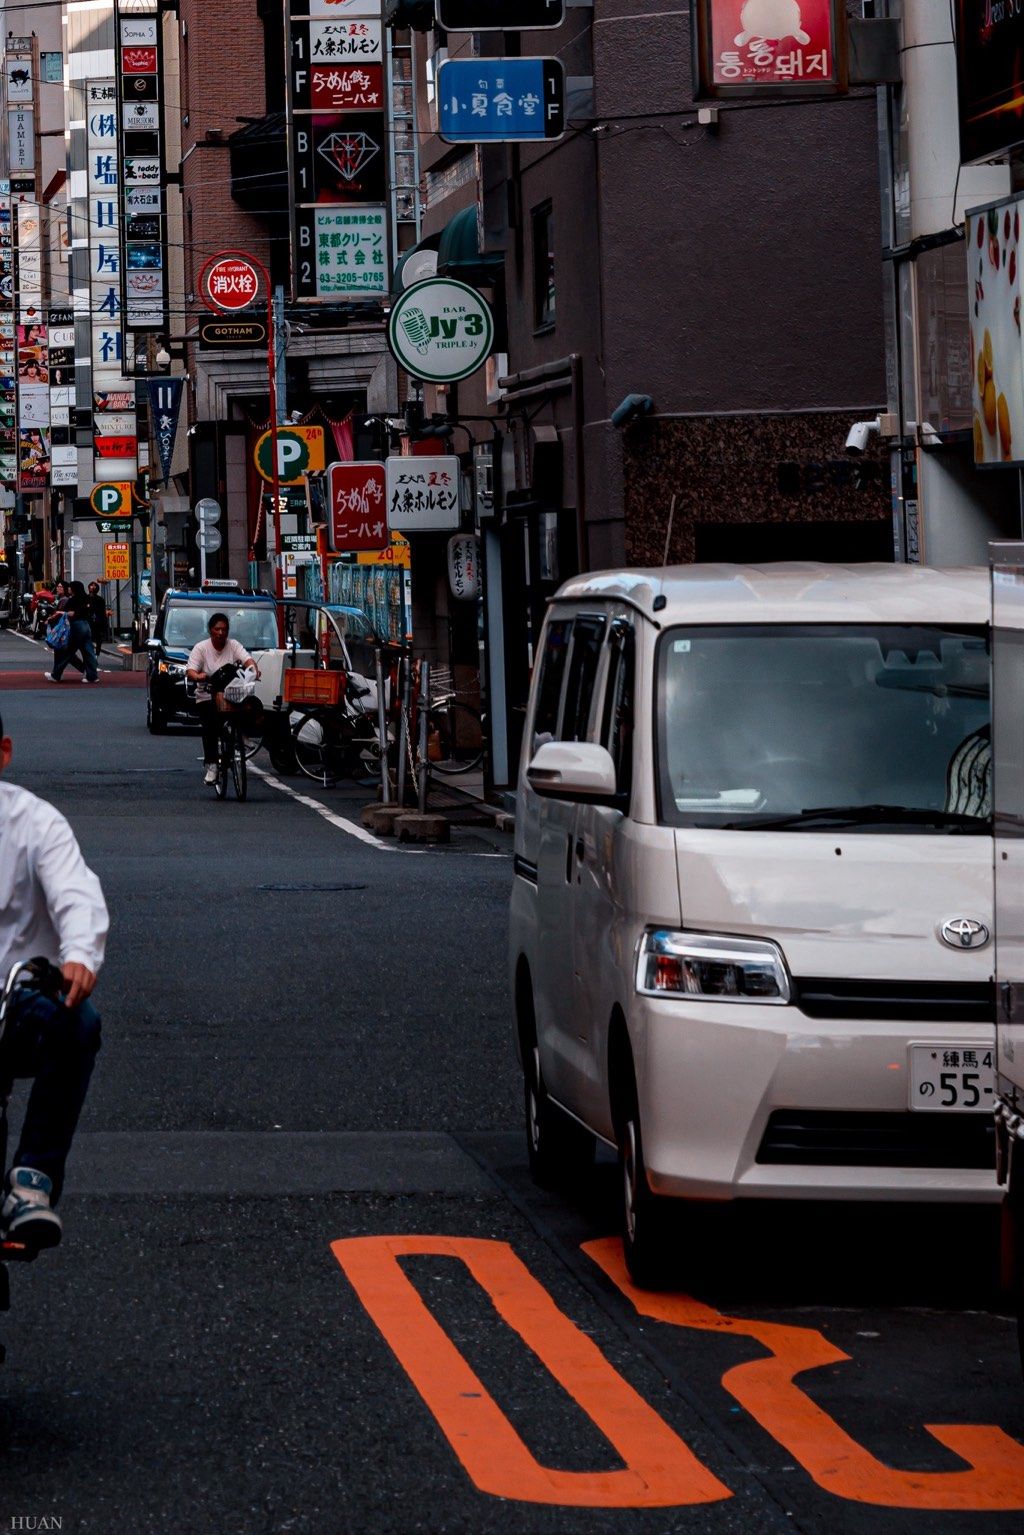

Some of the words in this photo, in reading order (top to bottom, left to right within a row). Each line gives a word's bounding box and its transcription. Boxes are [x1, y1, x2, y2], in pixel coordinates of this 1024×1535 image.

[313, 37, 380, 57] 大衆ホルモン
[332, 93, 379, 105] ニーハオ
[443, 92, 541, 117] 小夏食堂
[319, 232, 383, 248] 東都クリーン
[319, 251, 384, 266] 株式会社
[213, 275, 253, 294] 消火栓
[443, 306, 467, 314] BAR
[215, 328, 253, 336] GOTHAM
[435, 341, 468, 350] TRIPLE
[277, 439, 302, 475] P
[101, 490, 119, 512] P
[390, 489, 458, 513] 大衆ホルモン
[336, 520, 385, 540] ニーハオ
[943, 1052, 979, 1068] 練馬
[919, 1081, 935, 1096] の
